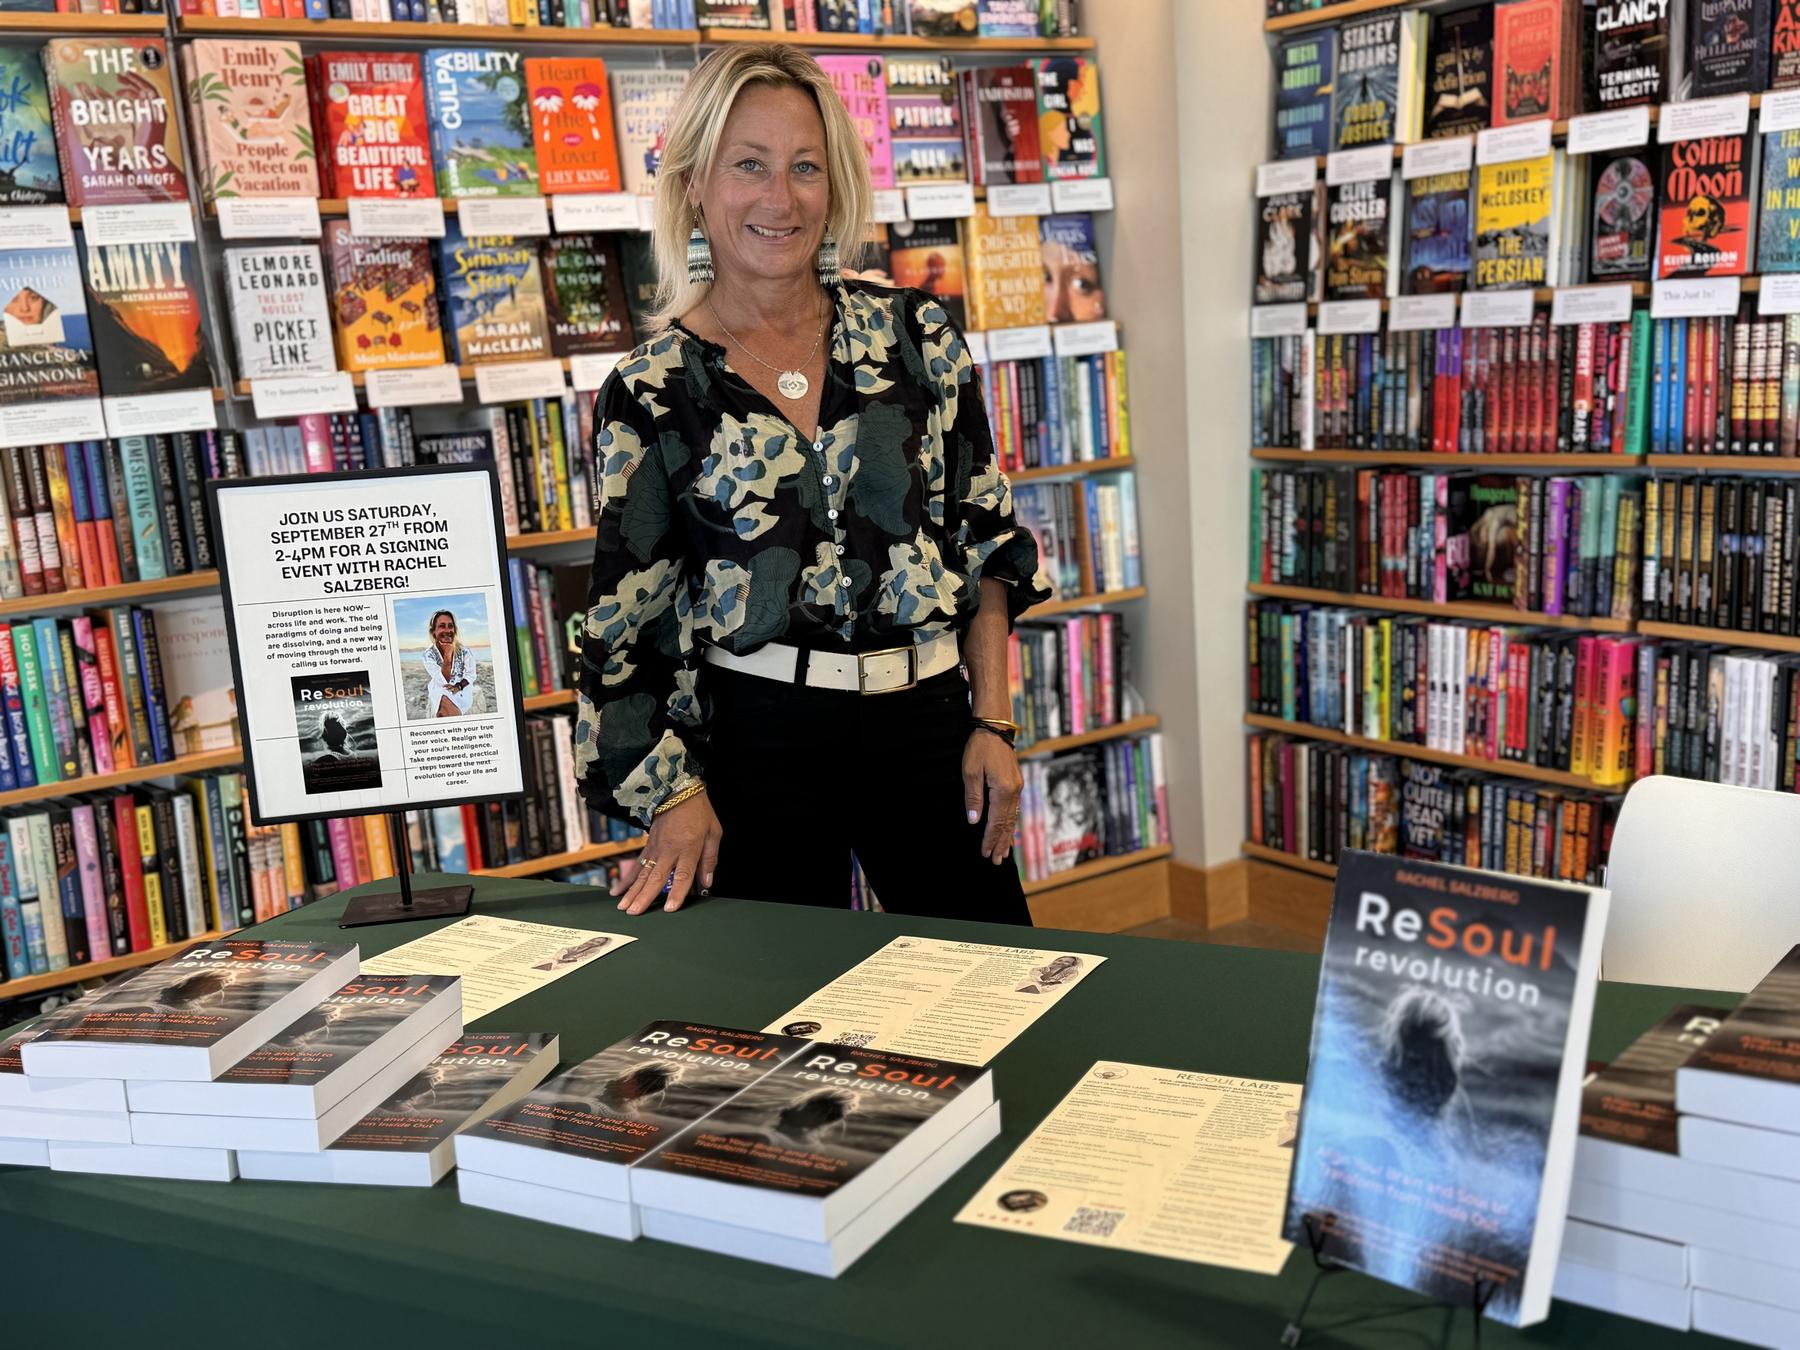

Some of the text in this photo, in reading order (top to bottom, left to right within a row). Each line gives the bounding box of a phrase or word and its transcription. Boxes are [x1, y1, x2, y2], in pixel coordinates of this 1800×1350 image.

[1596, 0, 1668, 31] CLANCY
[1343, 20, 1395, 50] STACEY
[84, 48, 136, 74] THE
[222, 47, 279, 68] Emily
[1339, 44, 1397, 74] ABRAMS
[222, 68, 286, 92] Henry
[328, 63, 414, 82] EMILY HENRY
[539, 64, 587, 81] Heart
[1600, 66, 1660, 87] TERMINAL
[1600, 81, 1660, 102] VELOCITY
[70, 99, 166, 126] BRIGHT
[348, 94, 408, 117] GREAT
[556, 112, 585, 128] the
[894, 107, 954, 128] PATRICK
[362, 120, 400, 144] BIG
[84, 146, 168, 171] YEARS
[237, 143, 288, 160] People
[336, 146, 426, 166] BEAUTIFUL
[551, 148, 600, 164] Lover
[222, 160, 308, 174] We Meet on
[576, 169, 610, 183] KING
[82, 175, 124, 188] SARAH
[234, 175, 300, 192] Vacation
[353, 168, 395, 190] LIFE
[1496, 168, 1529, 187] DAVID
[1668, 168, 1742, 202] Moon
[1330, 199, 1386, 224] CUSSLER
[1498, 236, 1522, 255] THE
[88, 242, 186, 292] AMITY
[241, 255, 313, 272] ELMORE
[354, 249, 412, 268] Ending
[574, 254, 606, 266] CAN
[1694, 251, 1738, 264] ROSSON
[556, 274, 602, 286] KNOW
[1478, 258, 1544, 284] PERSIAN
[238, 272, 319, 290] LEONARD
[254, 320, 317, 342] PICKET
[475, 322, 531, 338] SARAH
[270, 344, 312, 366] LINE
[0, 368, 86, 386] GIANNONE
[126, 439, 152, 518] OMESEEKING
[280, 504, 436, 526] JOIN US SATURDAY,
[271, 526, 365, 544] SEPTEMBER
[404, 520, 448, 534] FROM
[275, 538, 448, 562] 2-4PM FOR A SIGNING
[282, 556, 446, 579] EVENT WITH RACHEL
[324, 576, 409, 594] SALZBERG!
[272, 609, 314, 618] Disruption
[309, 618, 324, 626] and
[265, 631, 307, 640] paradigms
[319, 628, 342, 636] doing
[360, 624, 382, 633] being
[277, 651, 306, 660] moving
[308, 648, 339, 657] through
[356, 644, 378, 652] world
[282, 640, 324, 649] dissolving,
[291, 660, 317, 669] calling
[330, 656, 363, 665] forward.
[300, 684, 363, 701] ReSoul
[304, 700, 363, 711] revolution
[410, 729, 445, 737] Reconnect
[414, 748, 429, 756] your
[451, 743, 492, 751] intelligence.
[426, 753, 468, 762] empowered,
[470, 750, 498, 759] practical
[456, 770, 471, 778] your
[1411, 763, 1442, 784] NOT
[1404, 782, 1451, 804] QUITE
[1406, 804, 1442, 825] DEAD
[1410, 826, 1435, 845] YET
[1396, 870, 1520, 904] RACHEL SALZBERG
[1356, 891, 1556, 971] ReSoul
[182, 948, 327, 963] ReSoul
[172, 960, 302, 972] revolution
[1355, 946, 1540, 1007] revolution
[687, 1026, 764, 1041] RACHEL SALZBERG
[640, 1030, 779, 1060] ReSoul
[626, 1044, 750, 1070] revolution
[850, 1050, 939, 1069] RACHEL SALZBERG
[805, 1055, 957, 1089] ReSoul
[793, 1070, 930, 1100] revolution
[1176, 1073, 1280, 1091] RESOUL LABS
